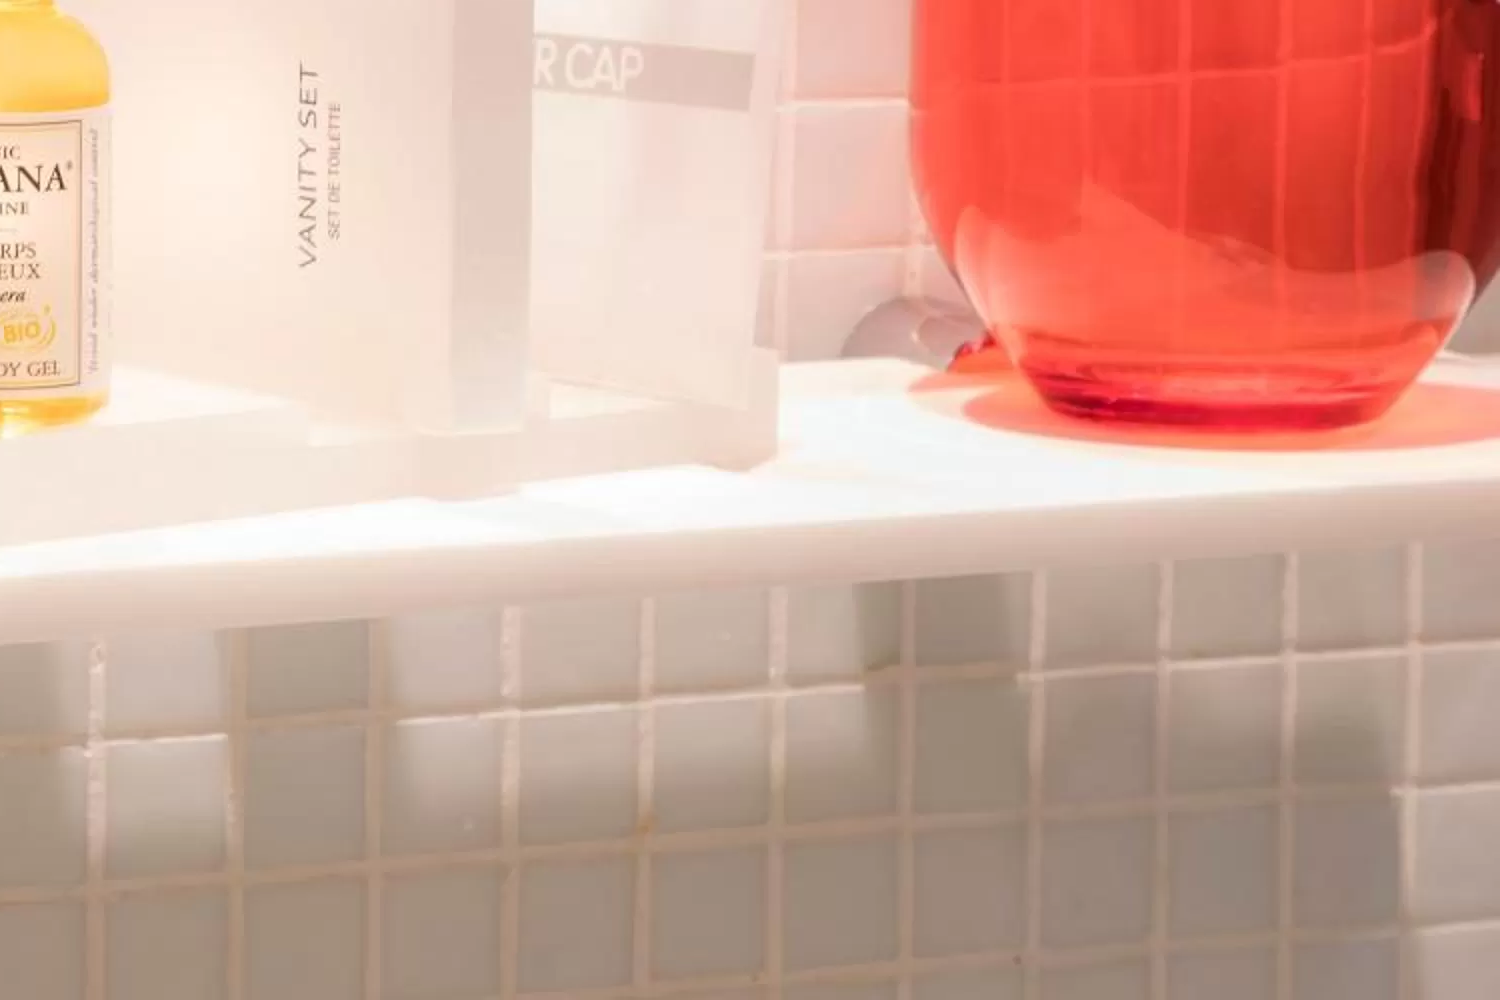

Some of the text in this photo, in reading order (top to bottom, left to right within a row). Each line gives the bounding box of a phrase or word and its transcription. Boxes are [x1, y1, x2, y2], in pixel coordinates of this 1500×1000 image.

[565, 43, 644, 91] CAP
[297, 59, 319, 268] VANITY SET
[327, 102, 341, 242] SET DE TOILETTE
[3, 321, 42, 344] BIO
[27, 360, 61, 377] GEL
